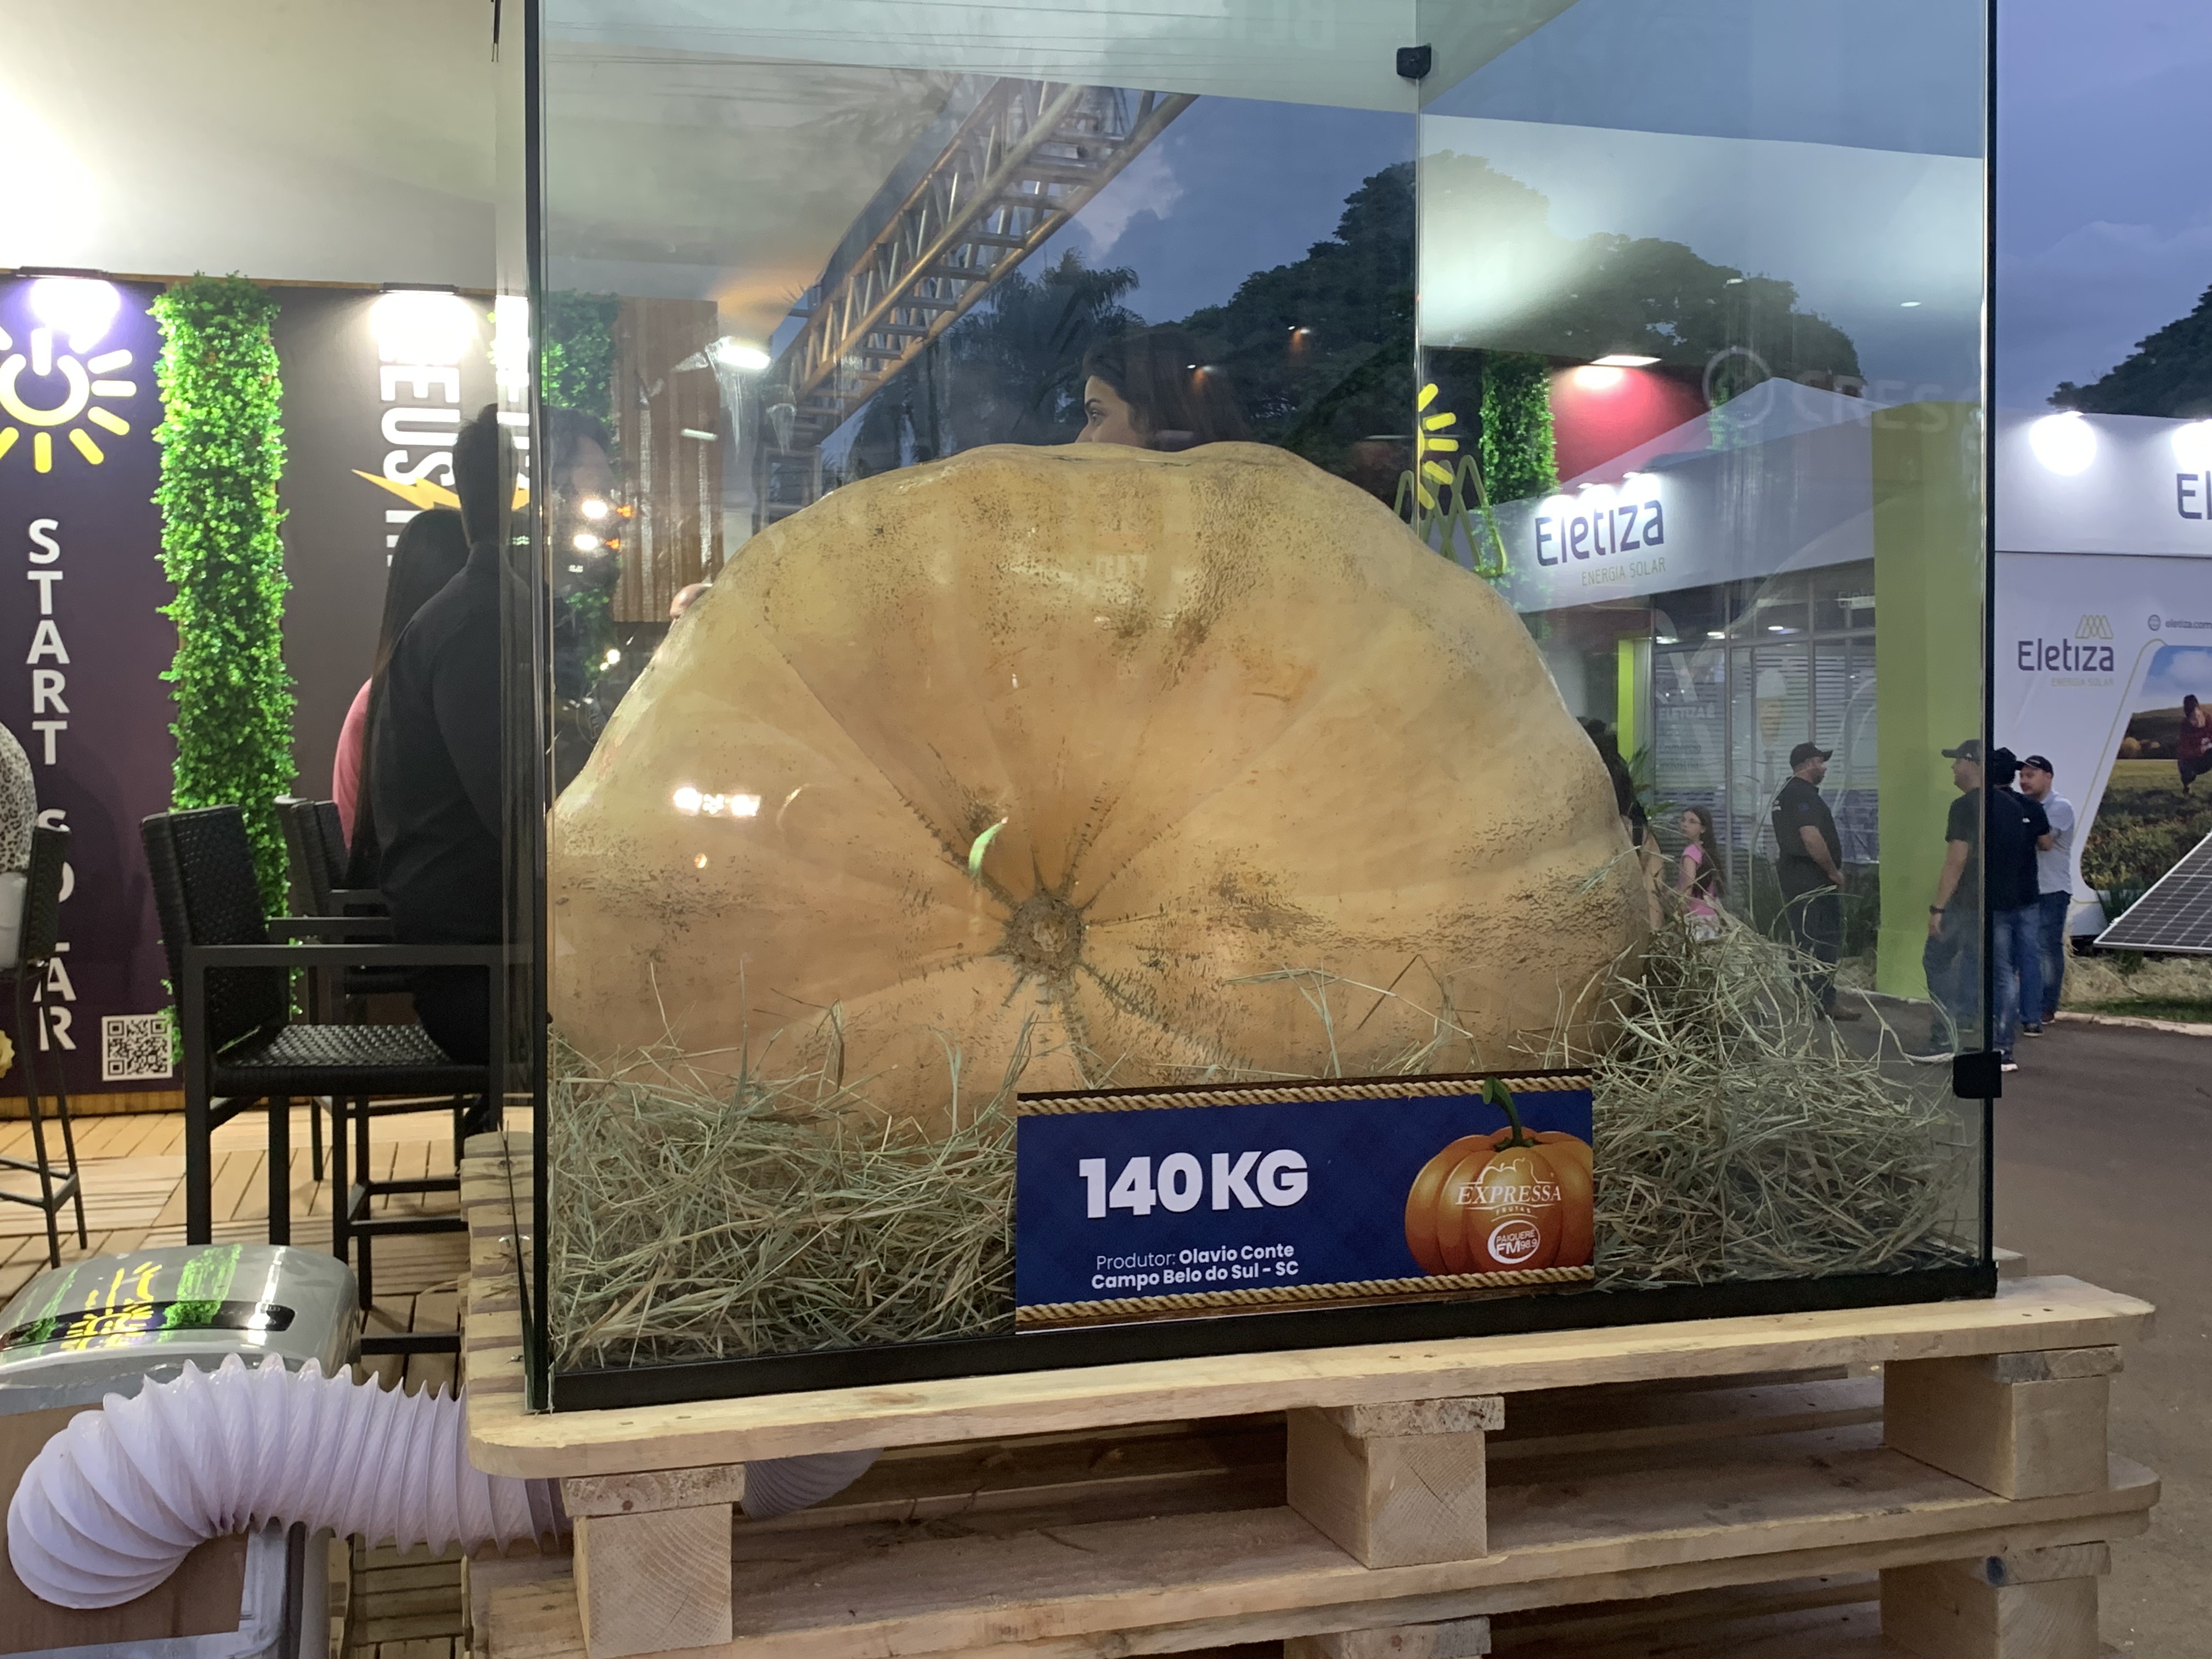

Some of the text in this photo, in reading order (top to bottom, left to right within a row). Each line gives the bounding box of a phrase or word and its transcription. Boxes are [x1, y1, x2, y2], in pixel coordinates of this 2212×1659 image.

[1535, 500, 1664, 566] Eletiza
[1581, 557, 1666, 586] ENERGIA SOLAR
[26, 518, 70, 765] START
[2017, 638, 2114, 672] Eletiza
[2088, 678, 2114, 687] SOLAR
[1079, 1149, 1308, 1218] 140 KG
[1455, 1183, 1562, 1205] EXPRESSA
[1496, 1206, 1531, 1216] FRUTAS
[1097, 1243, 1294, 1270] Produtor: Olavio Conte
[1092, 1273, 1160, 1290] Campo
[1164, 1267, 1202, 1284] Belo
[1205, 1266, 1228, 1280] do
[1231, 1263, 1259, 1279] Sul
[1276, 1261, 1299, 1276] SC
